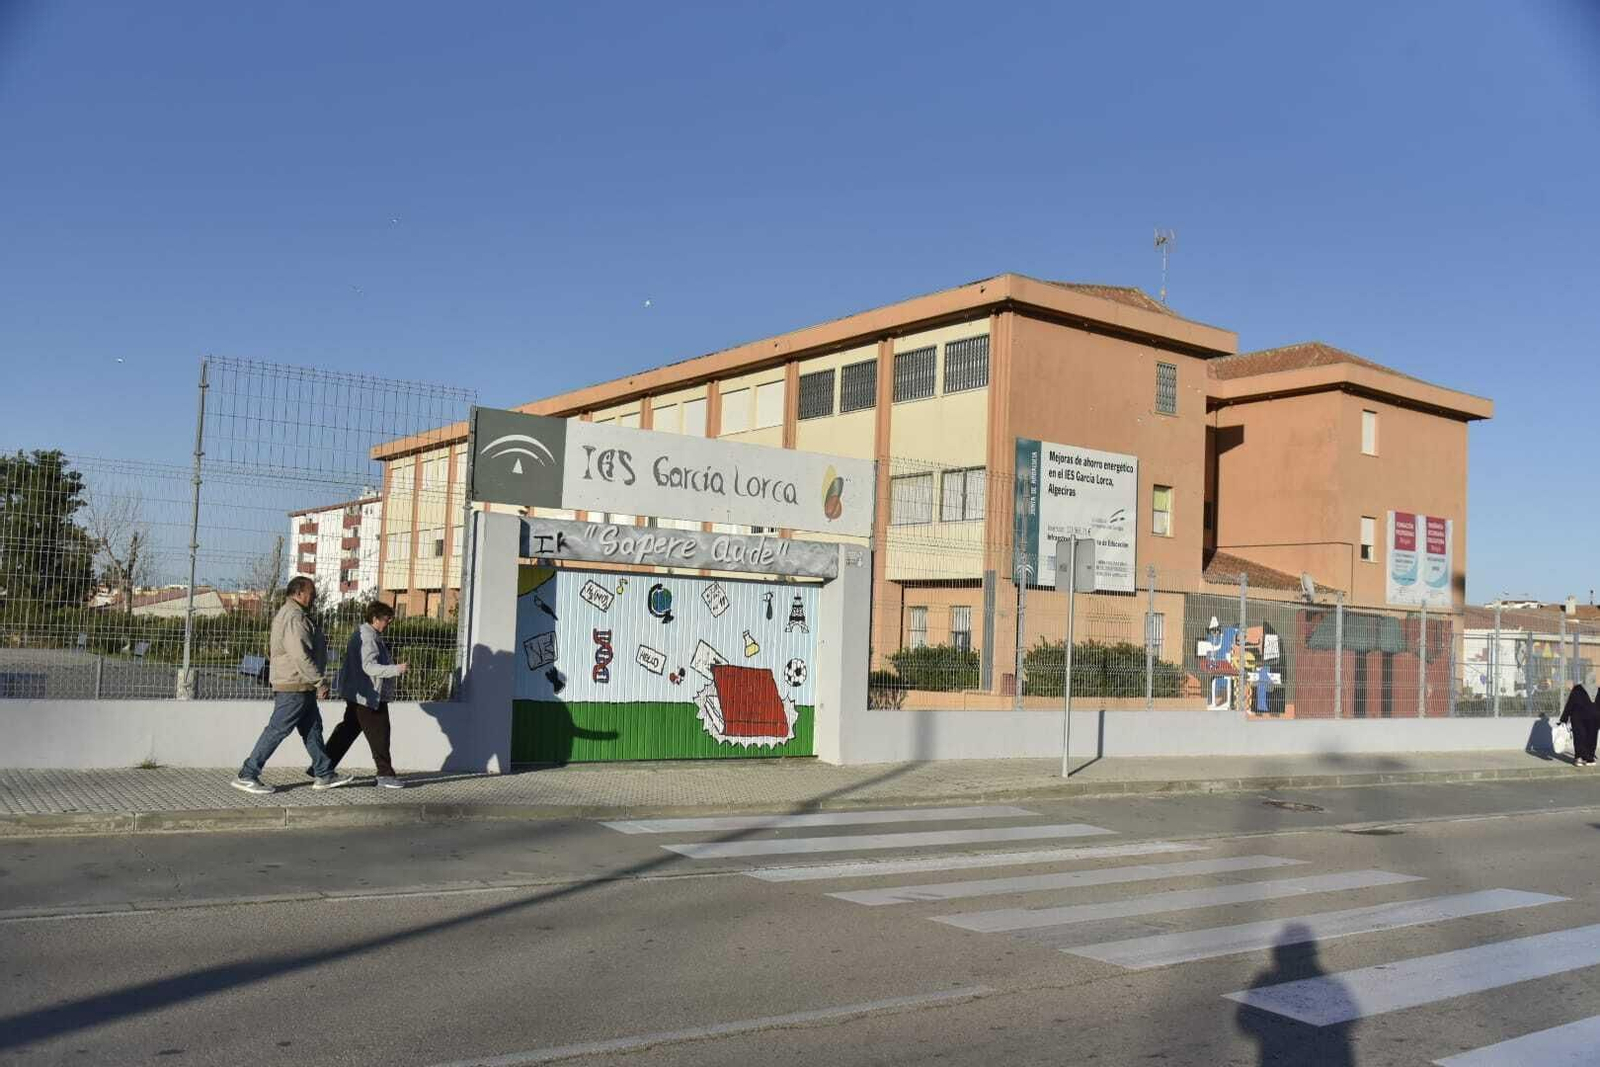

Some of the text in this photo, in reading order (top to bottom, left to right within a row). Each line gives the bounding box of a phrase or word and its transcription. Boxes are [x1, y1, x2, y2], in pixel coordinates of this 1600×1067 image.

[1049, 450, 1074, 465] Mejoras
[1074, 454, 1082, 466] de
[1083, 456, 1103, 470] ahorro
[1048, 469, 1057, 478] en
[1057, 468, 1064, 479] el
[1064, 469, 1075, 481] IES
[734, 465, 799, 506] Lorca
[1048, 482, 1076, 497] Algeciras
